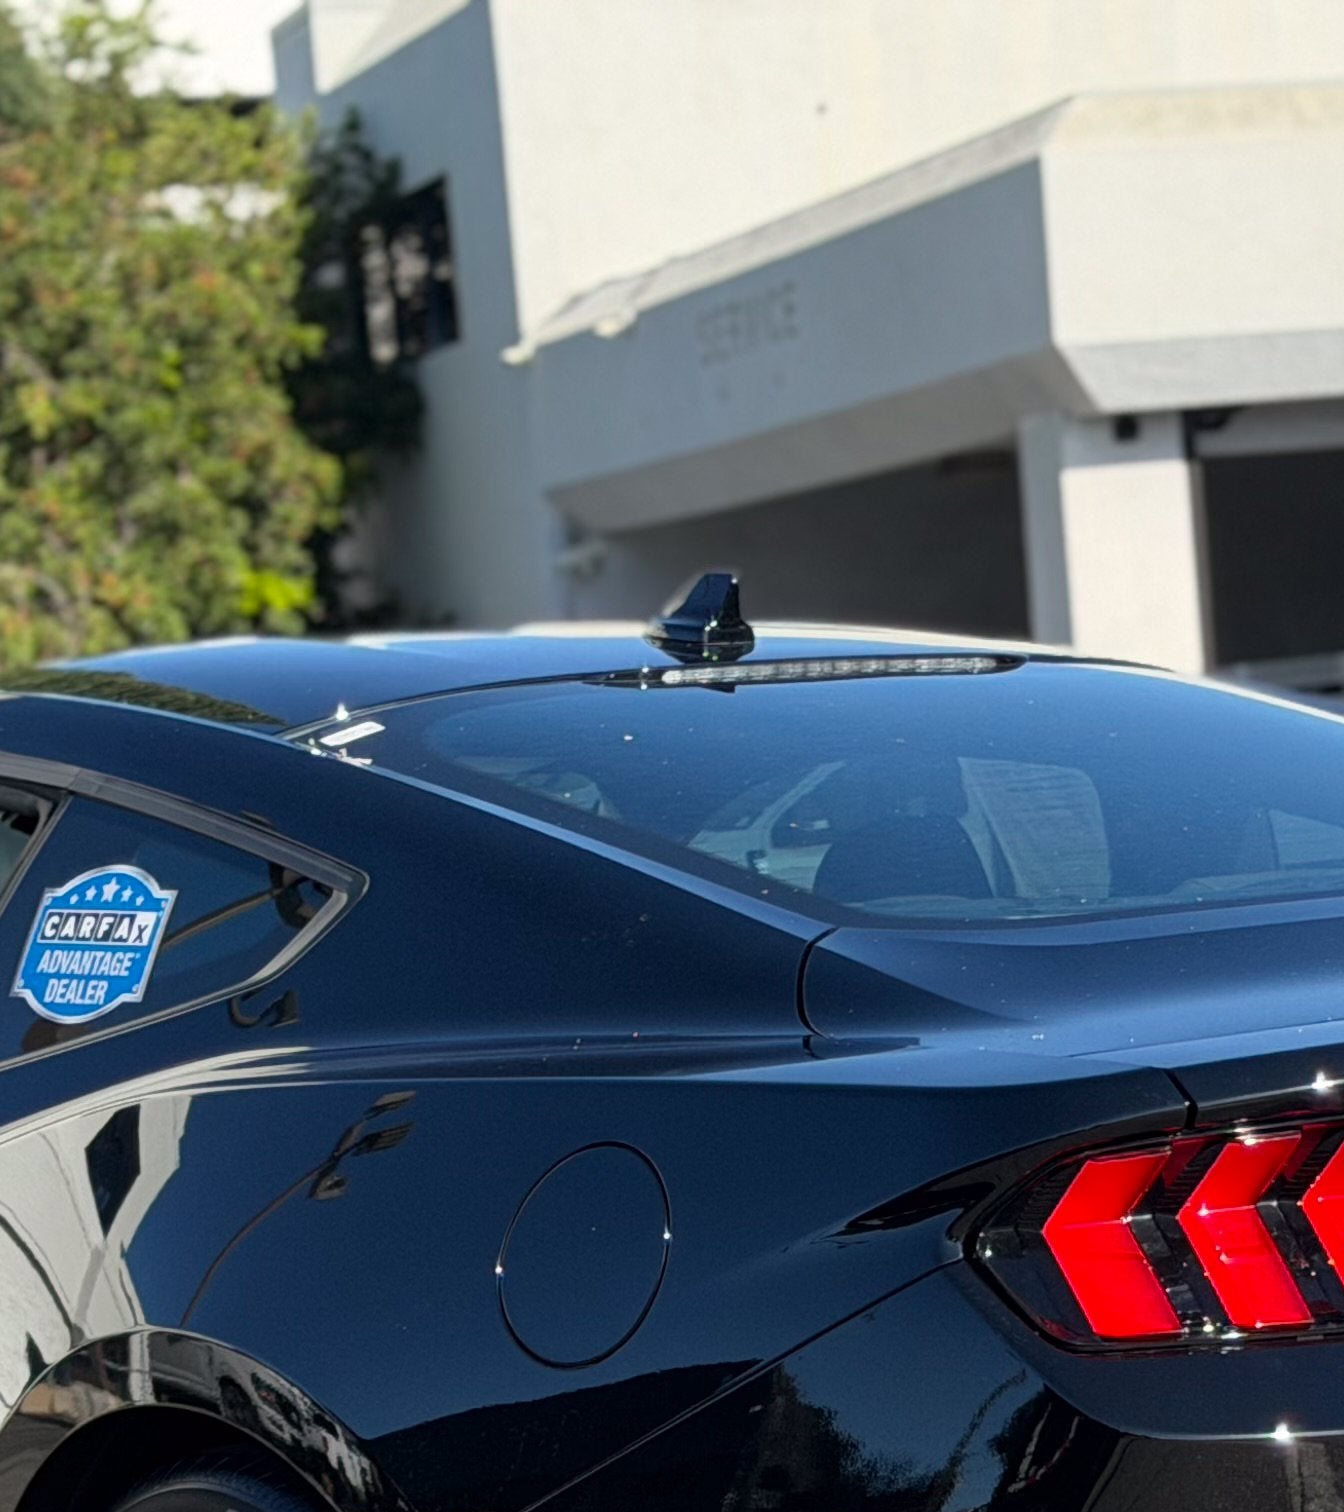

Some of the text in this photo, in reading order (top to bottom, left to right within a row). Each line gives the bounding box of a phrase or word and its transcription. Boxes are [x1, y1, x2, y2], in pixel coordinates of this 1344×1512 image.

[41, 912, 150, 944] CARFAX
[36, 949, 134, 977] ADVANTAGE
[43, 978, 109, 1005] DEALER
